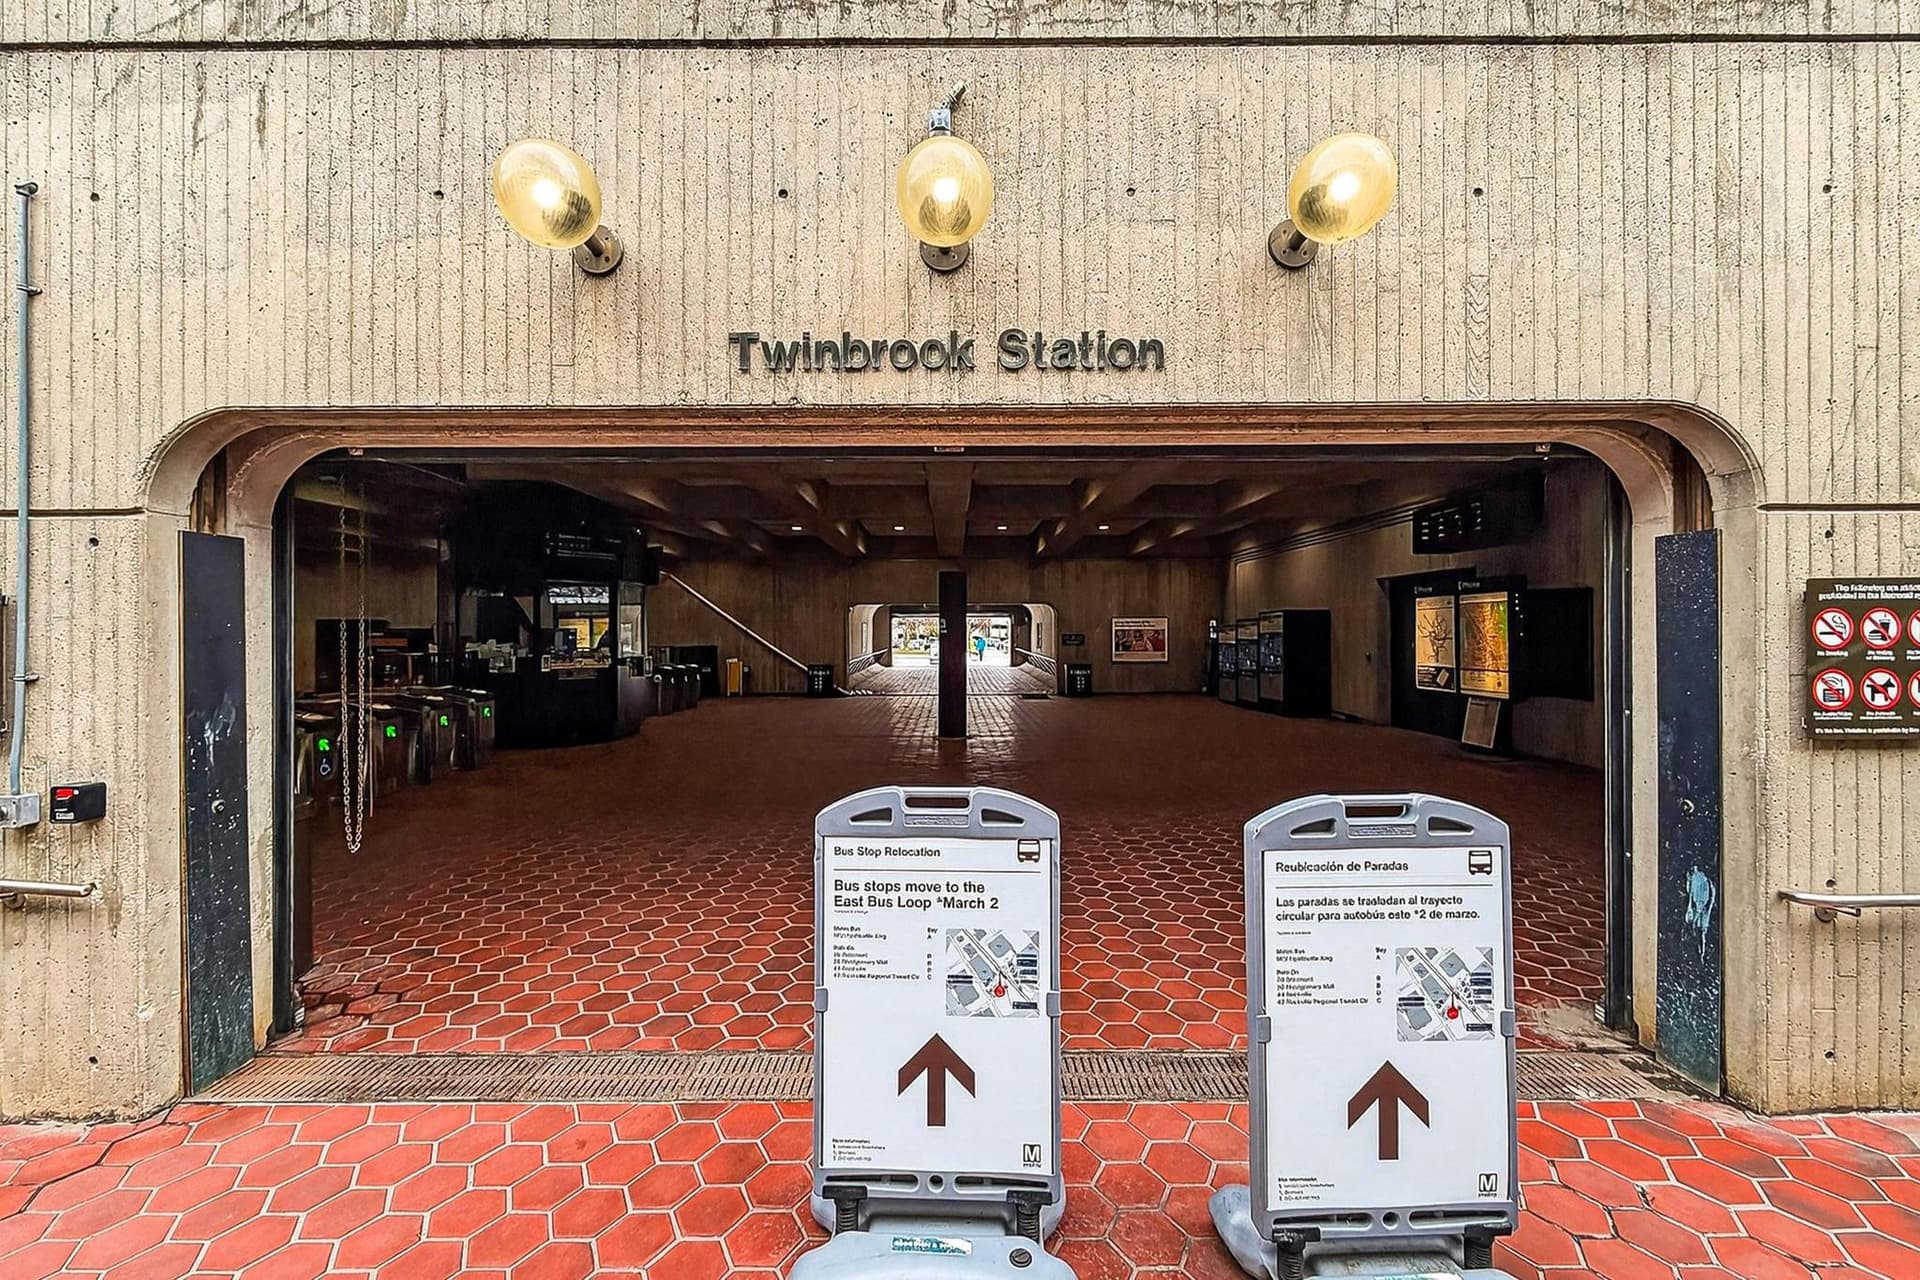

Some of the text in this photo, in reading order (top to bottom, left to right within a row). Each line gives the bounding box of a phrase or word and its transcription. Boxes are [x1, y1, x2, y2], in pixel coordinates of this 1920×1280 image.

[728, 328, 1165, 371] Twinbrook Station
[834, 846, 941, 859] Bus Stop Relocation
[1275, 861, 1409, 872] Reubicación de Paradas
[834, 879, 985, 894] Bus stops move to the
[834, 895, 864, 907] East
[867, 895, 894, 908] Bus
[897, 896, 932, 911] Loop
[990, 897, 999, 909] 2
[1276, 896, 1463, 908] Las paradas se trasladan al trayecto
[1275, 910, 1315, 921] circular
[1317, 912, 1341, 922] para
[1343, 909, 1386, 920] autobús
[1429, 909, 1443, 919] de
[1445, 910, 1480, 919] marzo.
[1025, 1145, 1040, 1161] M
[1480, 1174, 1496, 1191] M
